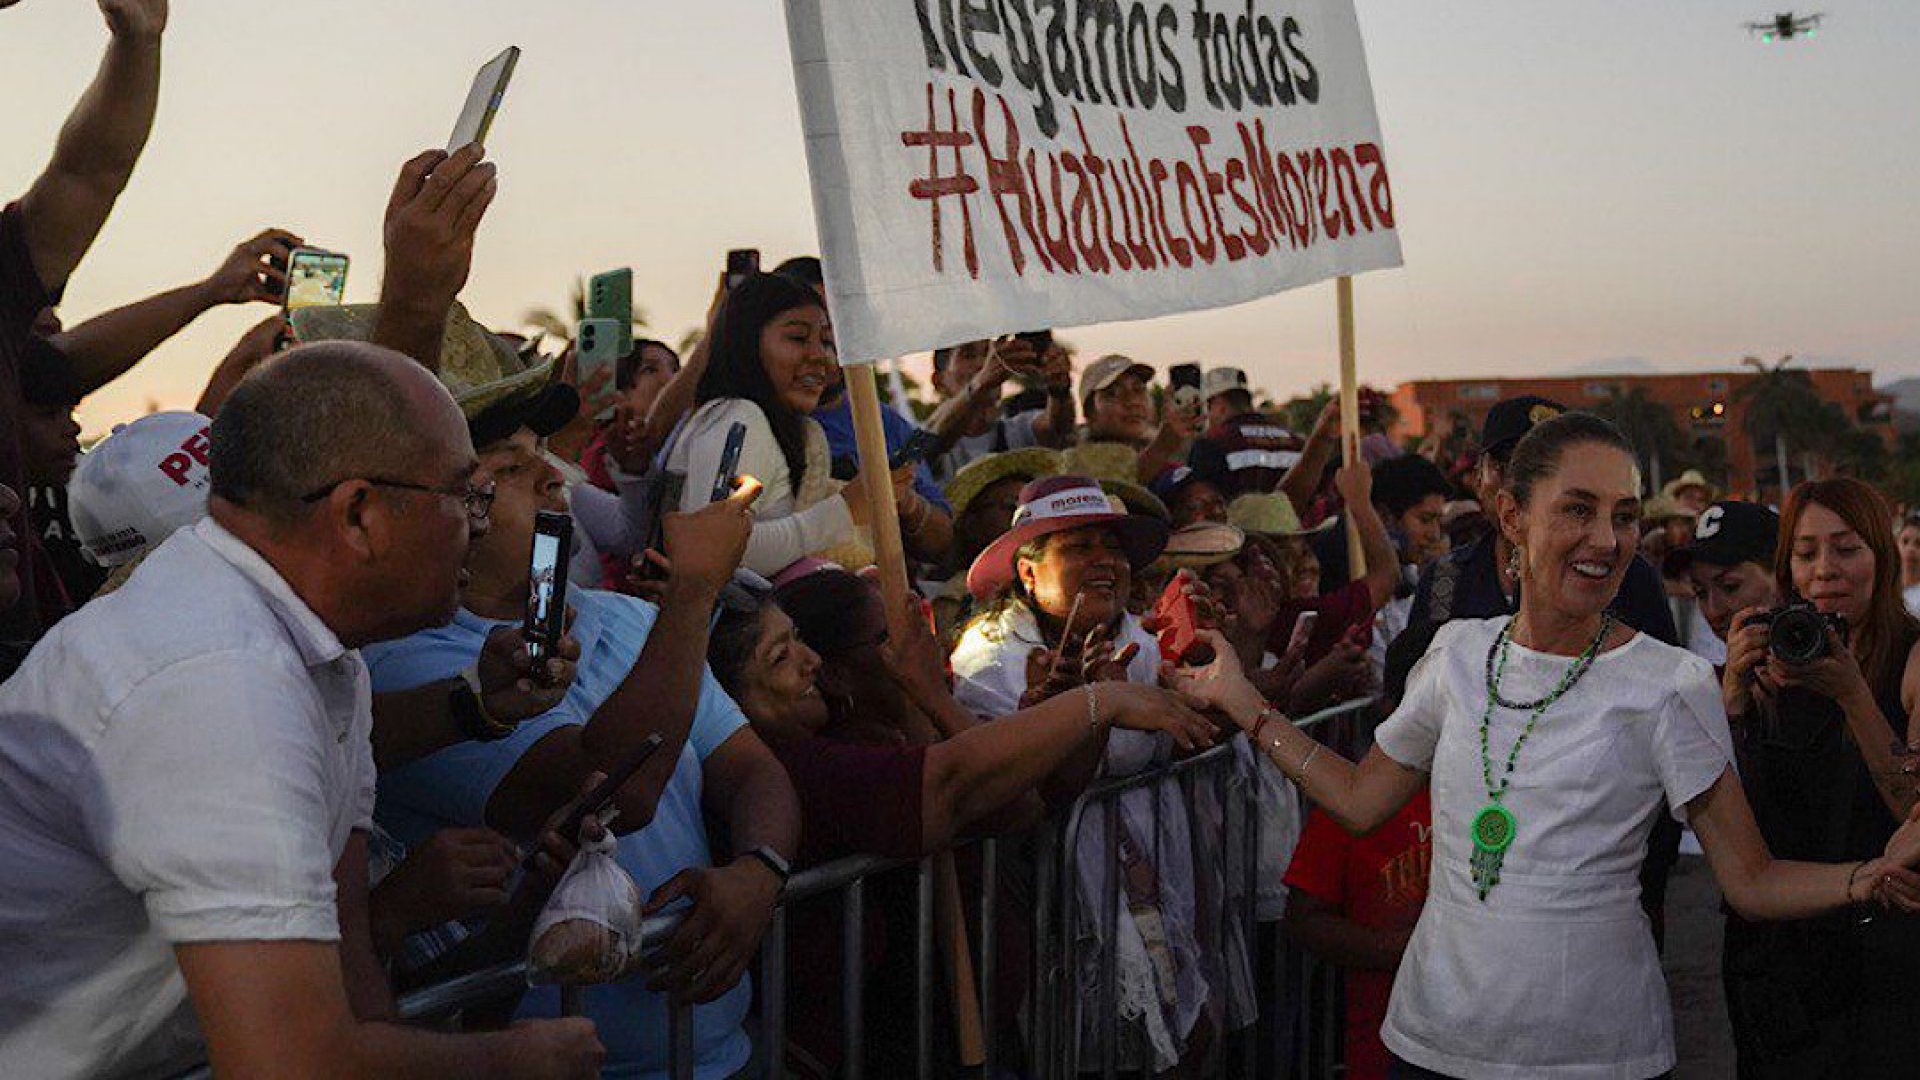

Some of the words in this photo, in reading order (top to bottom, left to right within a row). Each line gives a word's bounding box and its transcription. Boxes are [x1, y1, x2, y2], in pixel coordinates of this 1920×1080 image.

[1192, 0, 1319, 112] todas
[902, 82, 1395, 279] #HuatulcoEsMorena
[1695, 505, 1725, 540] C
